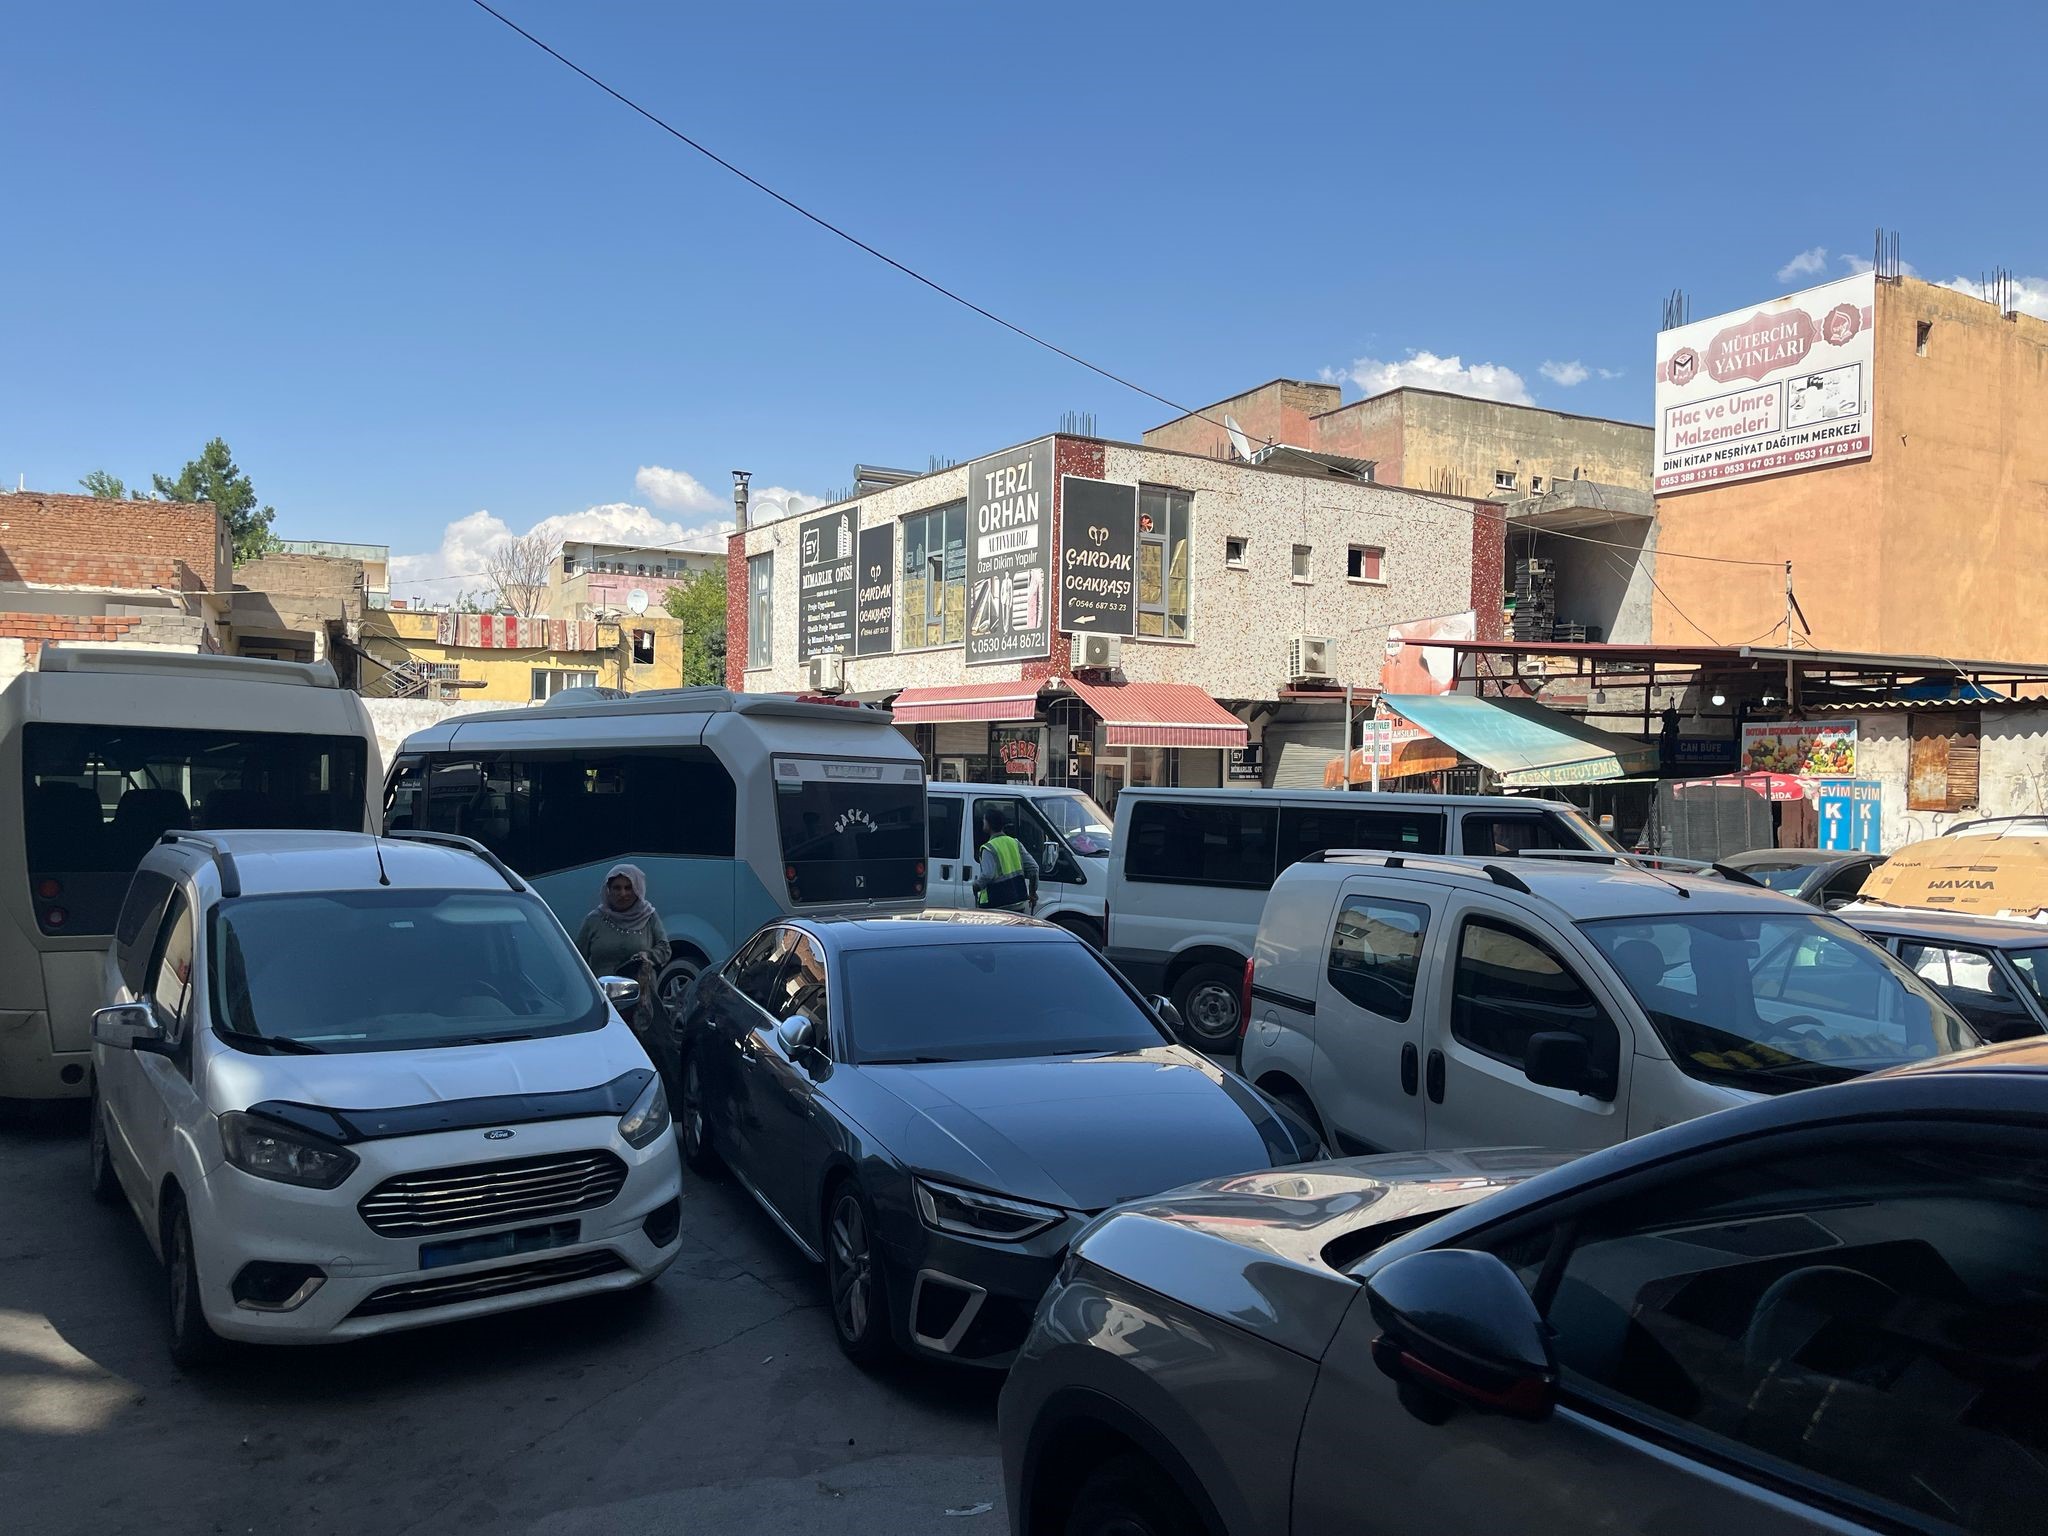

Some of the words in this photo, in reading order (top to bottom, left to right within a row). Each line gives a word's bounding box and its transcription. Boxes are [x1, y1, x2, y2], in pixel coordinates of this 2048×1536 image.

[1721, 322, 1799, 355] MÜTERCİM
[1714, 338, 1805, 375] YAYINLARI
[1671, 411, 1700, 428] Hac
[1705, 406, 1724, 420] ve
[1729, 393, 1774, 416] Umre
[1675, 413, 1769, 447] Malzemeleri
[1663, 458, 1682, 471] DİNİ
[1684, 452, 1712, 467] KİTAP
[1714, 442, 1763, 462] NEŞRİYAT
[1766, 433, 1809, 450] DAĞITIM
[1811, 420, 1861, 441] MERKEZİ
[1660, 476, 1679, 486] 0553
[1697, 470, 1706, 479] 13
[1708, 468, 1718, 477] 15
[1725, 463, 1745, 474] 0533
[1747, 460, 1760, 470] 147
[1763, 457, 1774, 466] 03
[1776, 455, 1786, 464] 21
[1794, 449, 1816, 460] 0533
[1818, 445, 1834, 456] 147
[1837, 443, 1848, 453] 03
[1851, 441, 1862, 451] 10
[985, 453, 1033, 501] TERZİ
[978, 491, 1039, 533] ORHAN
[994, 554, 1013, 570] Dikim
[1065, 548, 1132, 571] ÇARDAK
[802, 569, 833, 590] MİMARLIK
[835, 561, 853, 582] OFİSİ
[1065, 575, 1131, 599] OCAKBAŞI
[859, 583, 892, 607] ÇARDAK
[1075, 600, 1094, 609] 0546
[859, 606, 891, 623] OCAKBAŞI
[978, 637, 1000, 653] 0530
[1001, 635, 1018, 651] 644
[1020, 633, 1041, 649] 8672
[1393, 717, 1403, 728] 16
[1820, 784, 1850, 797] EVİM
[1854, 784, 1880, 800] EVİM
